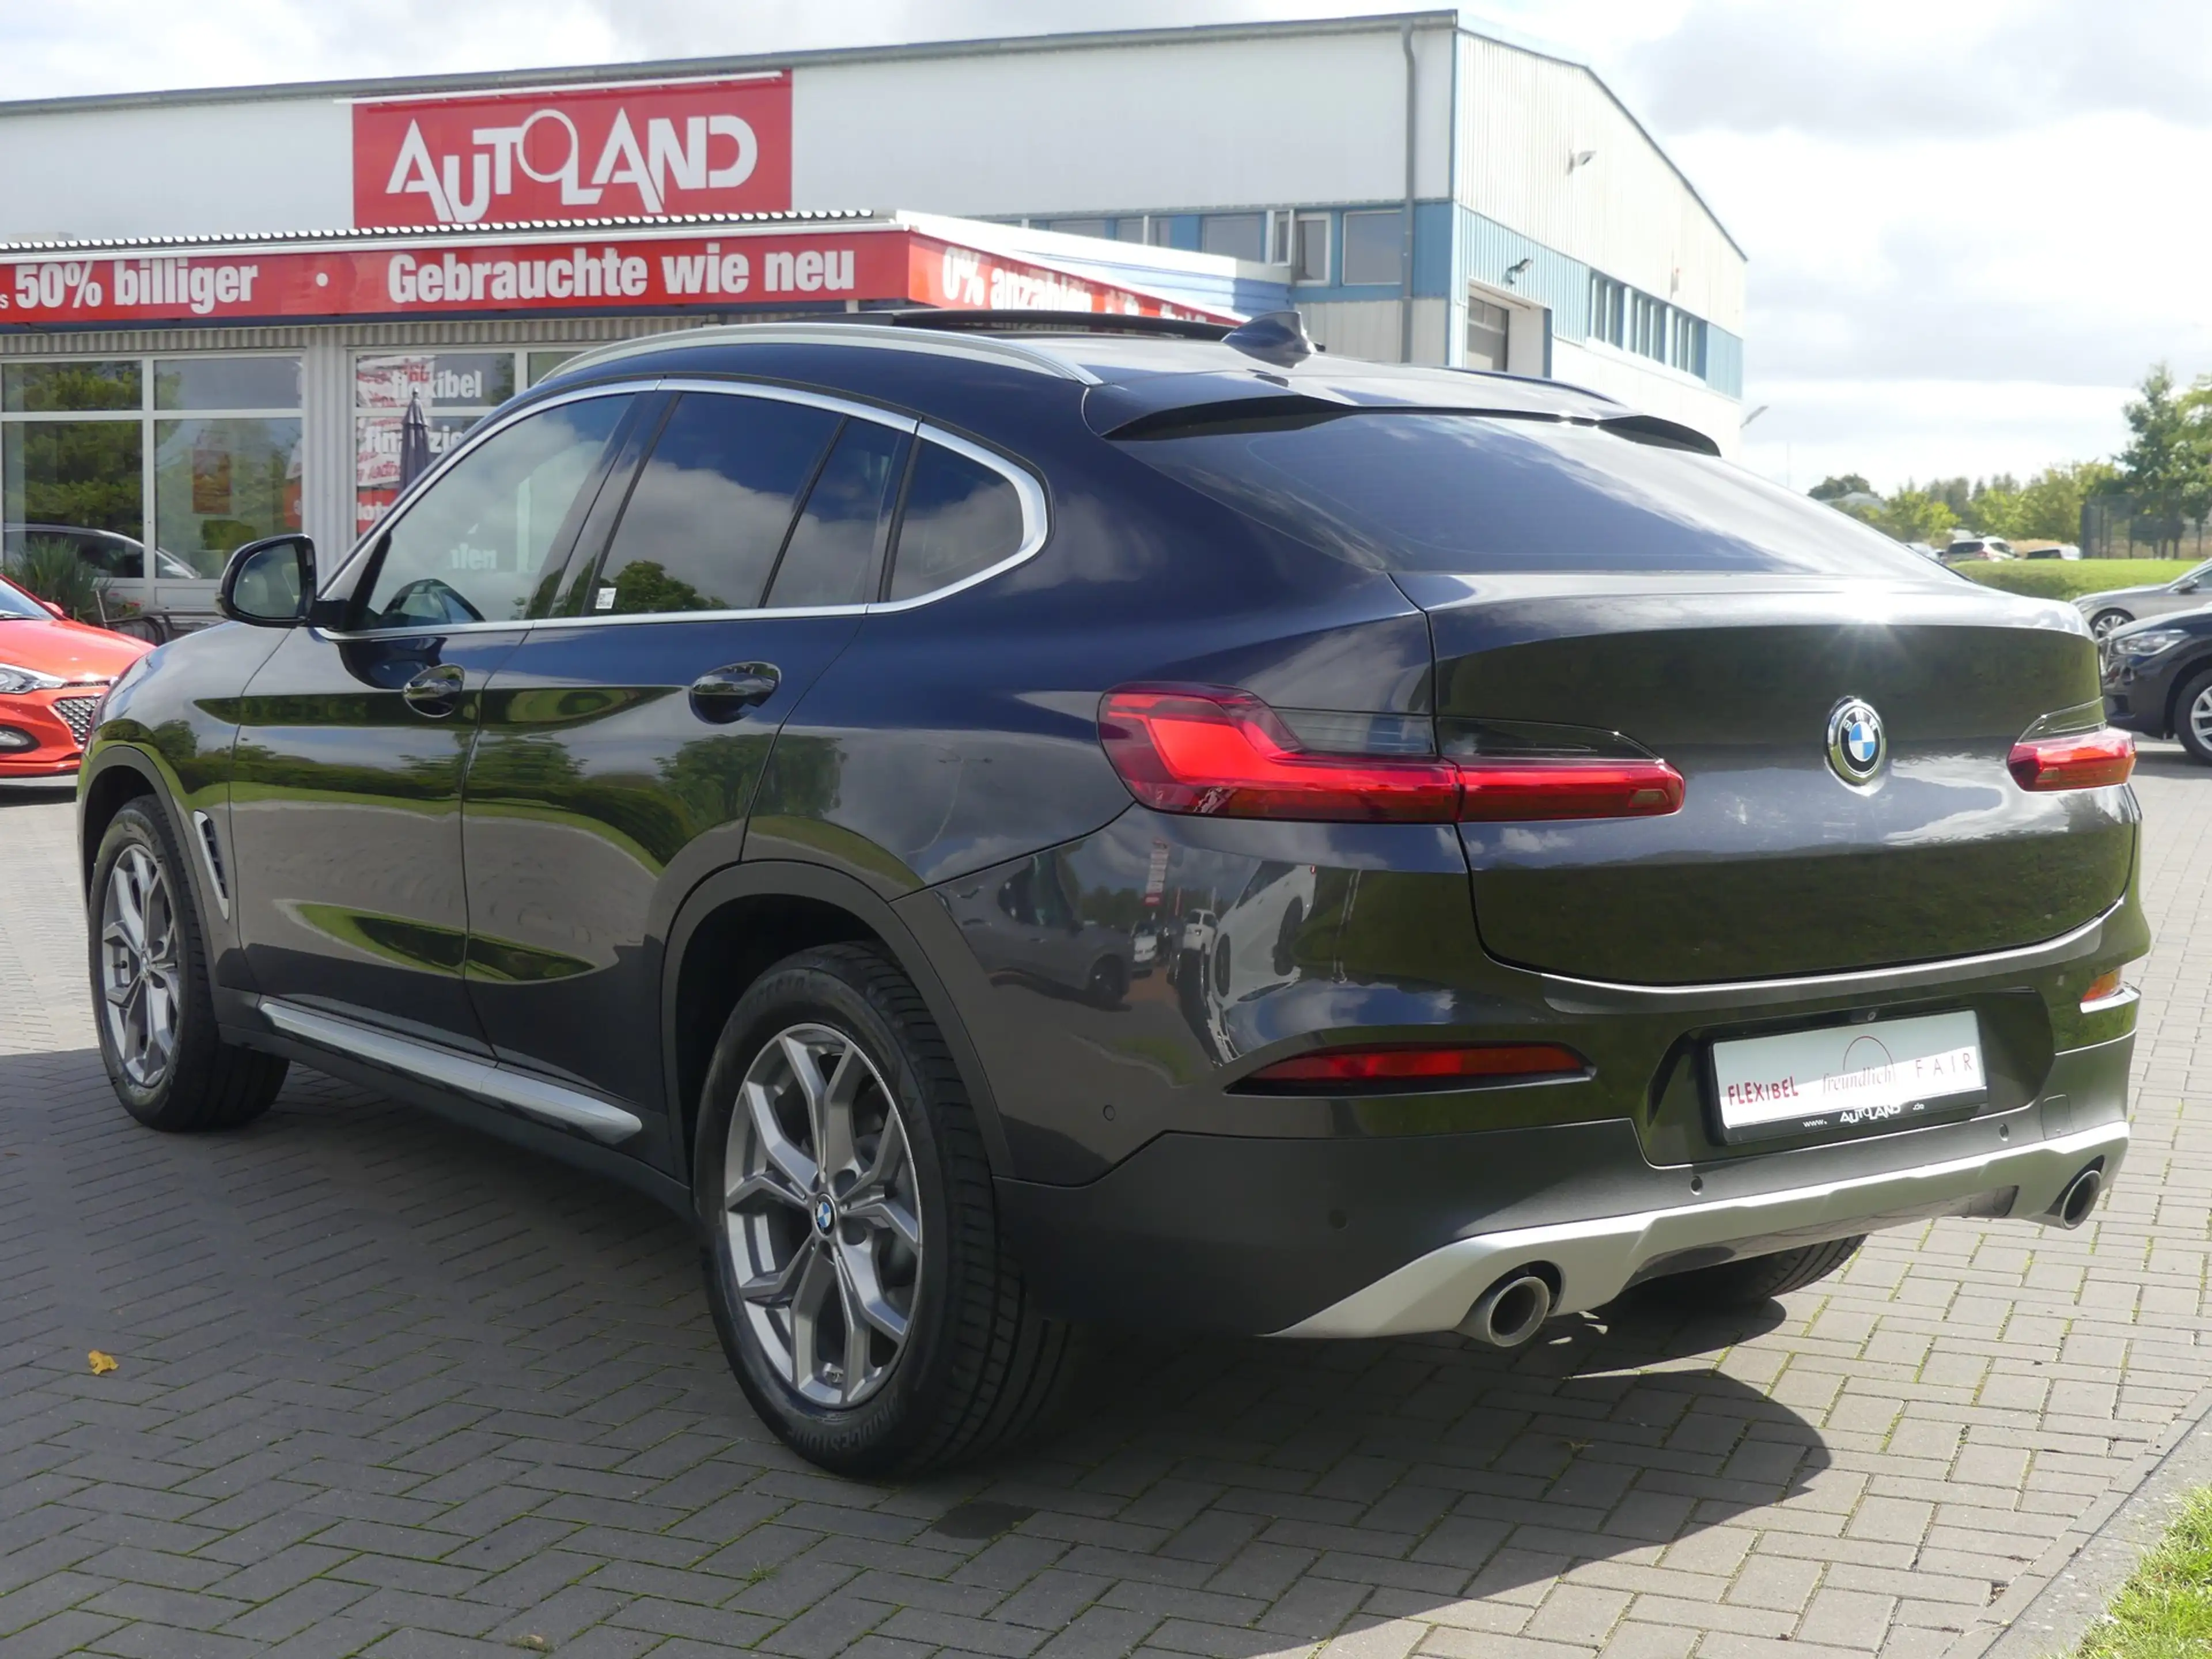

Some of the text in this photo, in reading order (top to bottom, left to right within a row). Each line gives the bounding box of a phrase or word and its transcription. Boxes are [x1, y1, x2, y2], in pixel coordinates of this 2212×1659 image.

[385, 107, 757, 222] AUTOLAND
[15, 260, 103, 309] 50%
[114, 257, 258, 315] billiger
[388, 248, 648, 304] Gebrauchte
[661, 243, 749, 295] wie
[764, 250, 855, 293] neu
[942, 247, 984, 306] 0%
[1728, 1075, 1799, 1106] FLEXIBEL
[1822, 1065, 1893, 1094] freundlich
